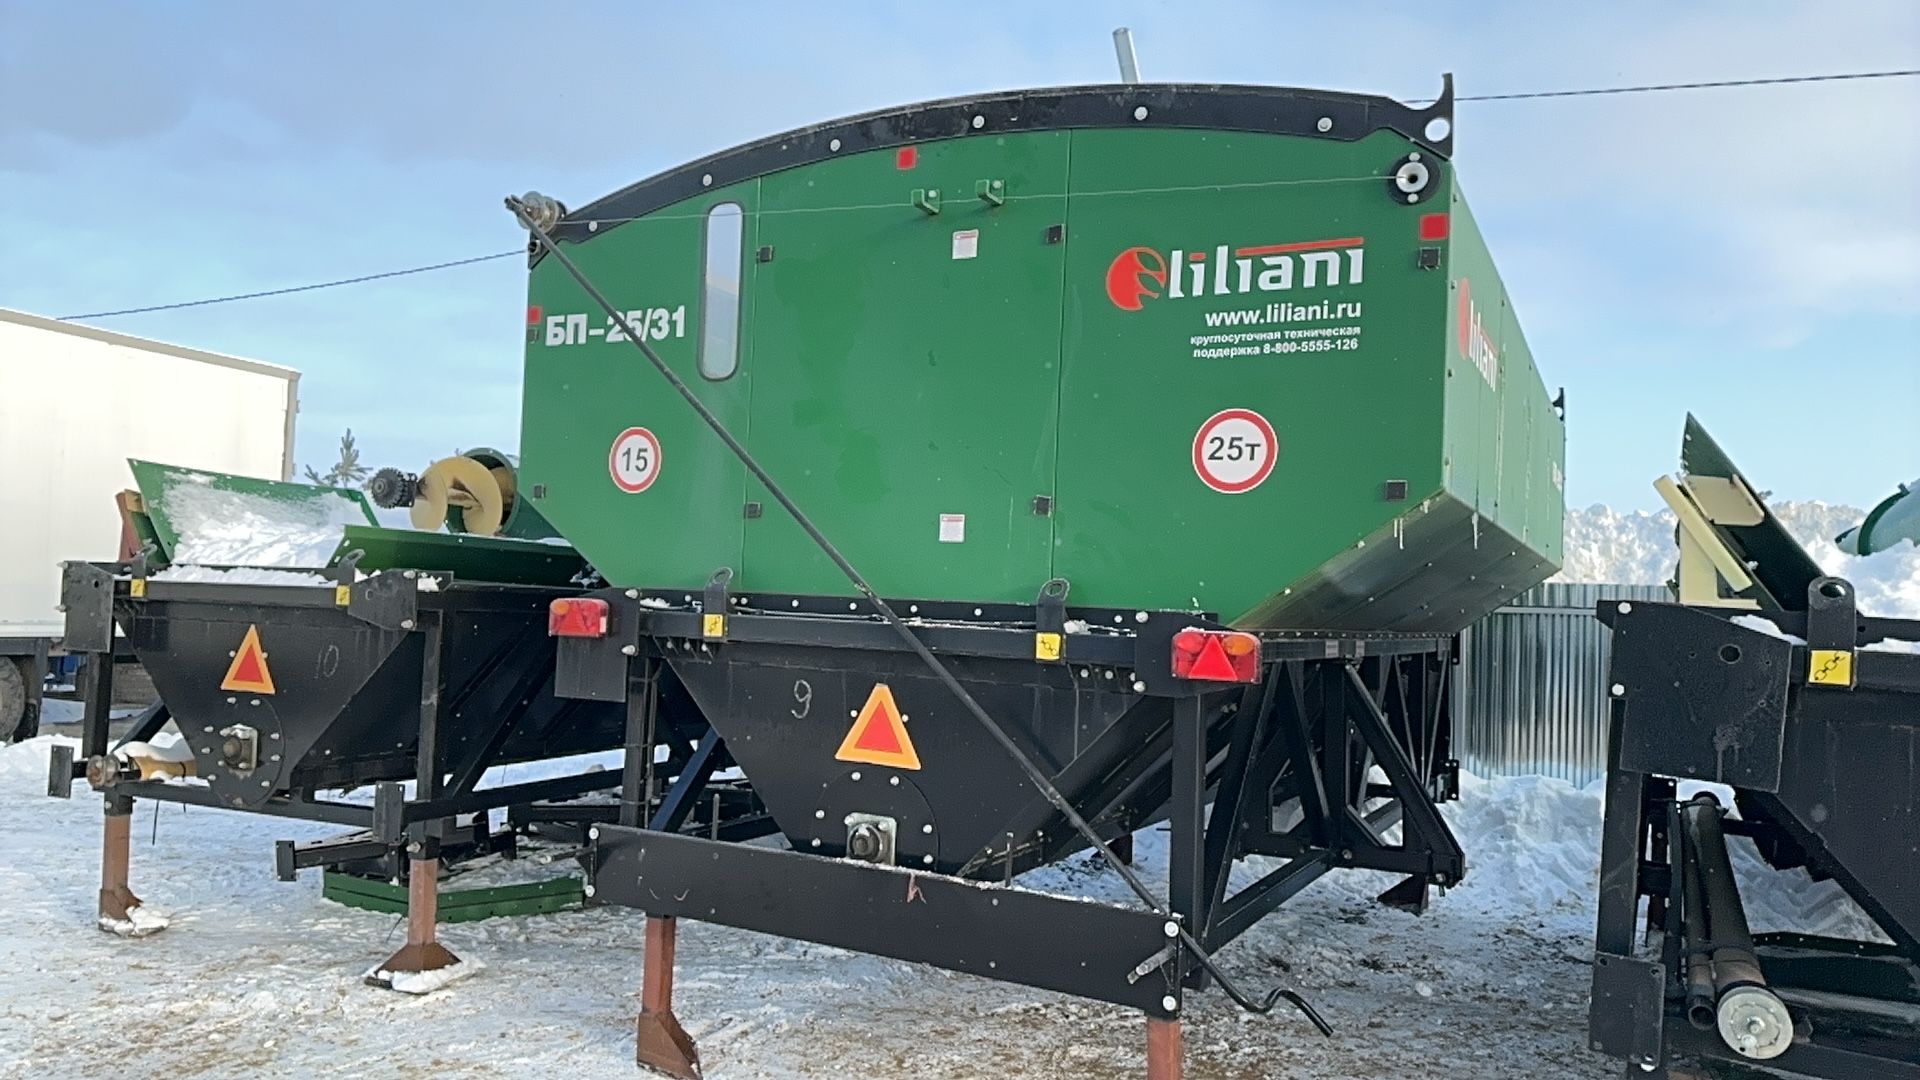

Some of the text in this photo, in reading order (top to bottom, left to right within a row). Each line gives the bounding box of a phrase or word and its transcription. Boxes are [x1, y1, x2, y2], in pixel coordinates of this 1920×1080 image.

[545, 305, 686, 346] БП-25/31
[1205, 299, 1362, 327] www.liliani.ru
[1190, 326, 1361, 346] круглосуточная техническая
[1193, 338, 1359, 359] поддержка 8-800-5555-126
[622, 447, 648, 473] 15
[791, 679, 812, 719] 9
